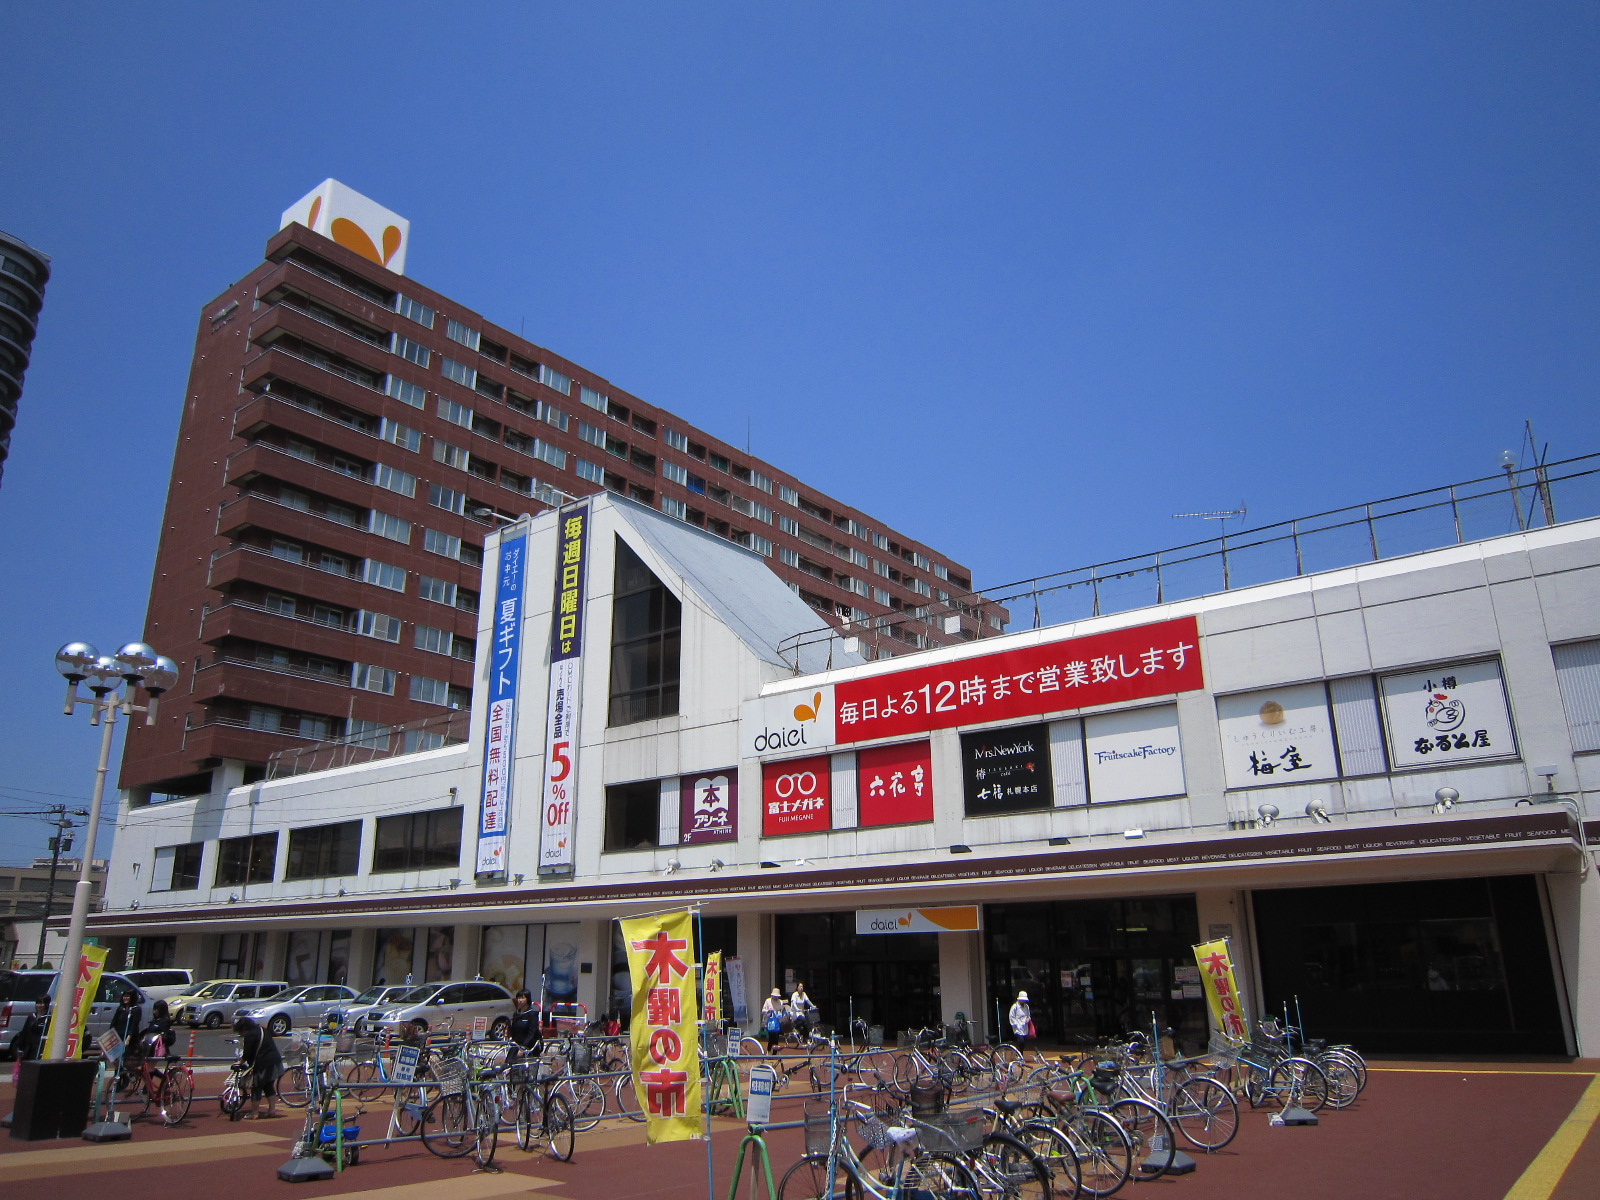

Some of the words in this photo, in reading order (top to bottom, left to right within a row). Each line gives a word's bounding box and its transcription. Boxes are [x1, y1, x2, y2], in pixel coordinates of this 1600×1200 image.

[502, 551, 512, 588] お中元
[510, 548, 520, 591] ダイエーの
[560, 515, 582, 654] 毎週日曜日は
[498, 598, 518, 695] 夏ギフト
[839, 641, 1194, 726] 毎日よる12時まで営業致します
[1423, 676, 1458, 692] 小樽
[754, 724, 807, 752] daiei
[1414, 730, 1491, 754] なると屋
[869, 764, 924, 798] 六花亭
[702, 784, 720, 808] 本
[768, 796, 825, 814] 富士メガネ
[694, 810, 728, 828] アシーネ
[790, 814, 814, 822] MEGANE
[684, 832, 692, 842] 2F
[870, 918, 898, 931] daiei
